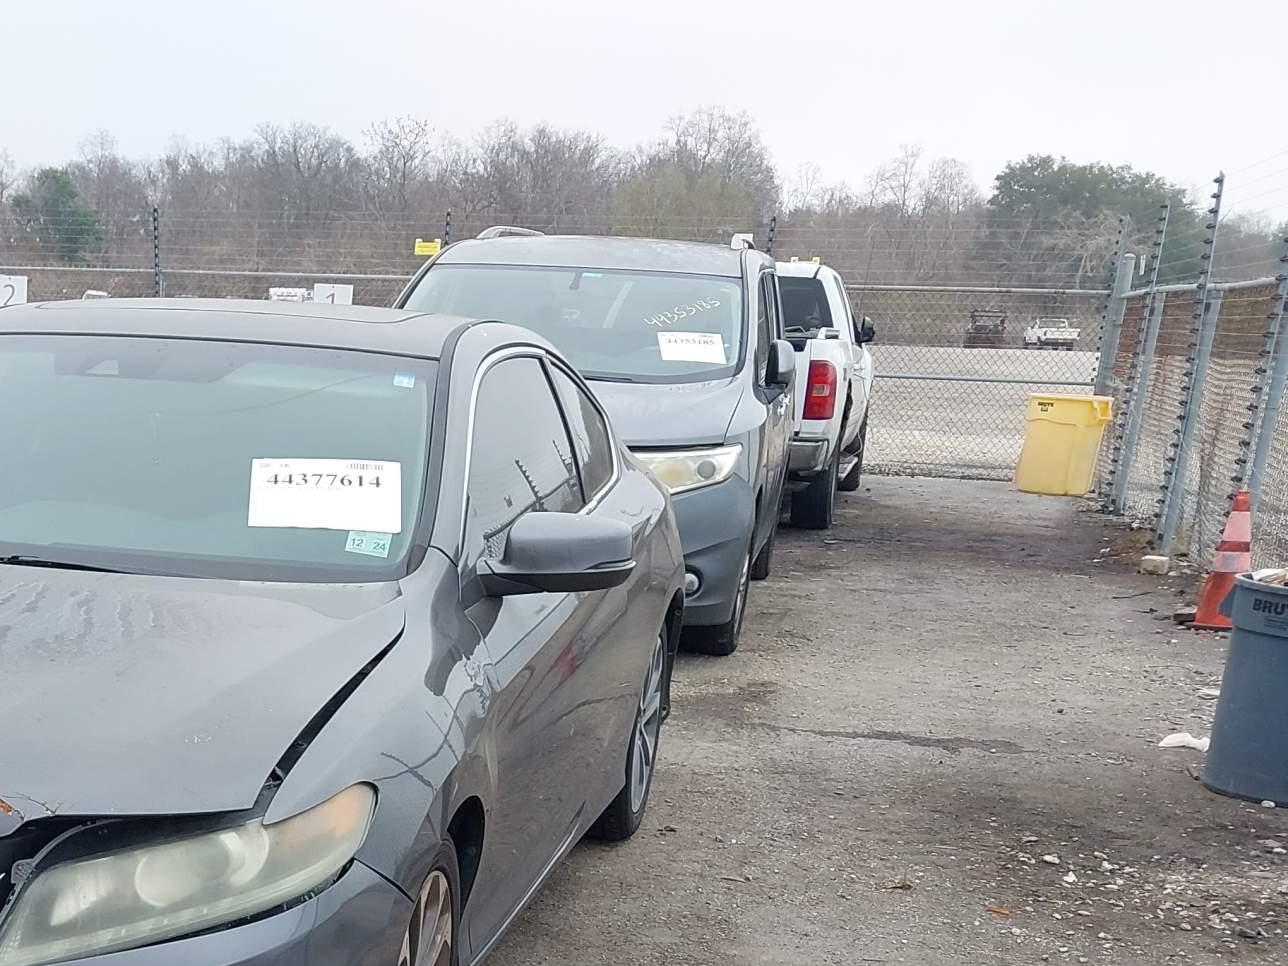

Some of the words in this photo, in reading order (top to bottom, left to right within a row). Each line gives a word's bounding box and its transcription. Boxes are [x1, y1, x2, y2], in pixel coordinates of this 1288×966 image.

[3, 284, 16, 305] 2
[643, 296, 721, 328] 44353185
[266, 473, 382, 488] 44377614
[351, 538, 364, 548] 12
[373, 541, 387, 552] 24
[1252, 598, 1288, 616] BRU
